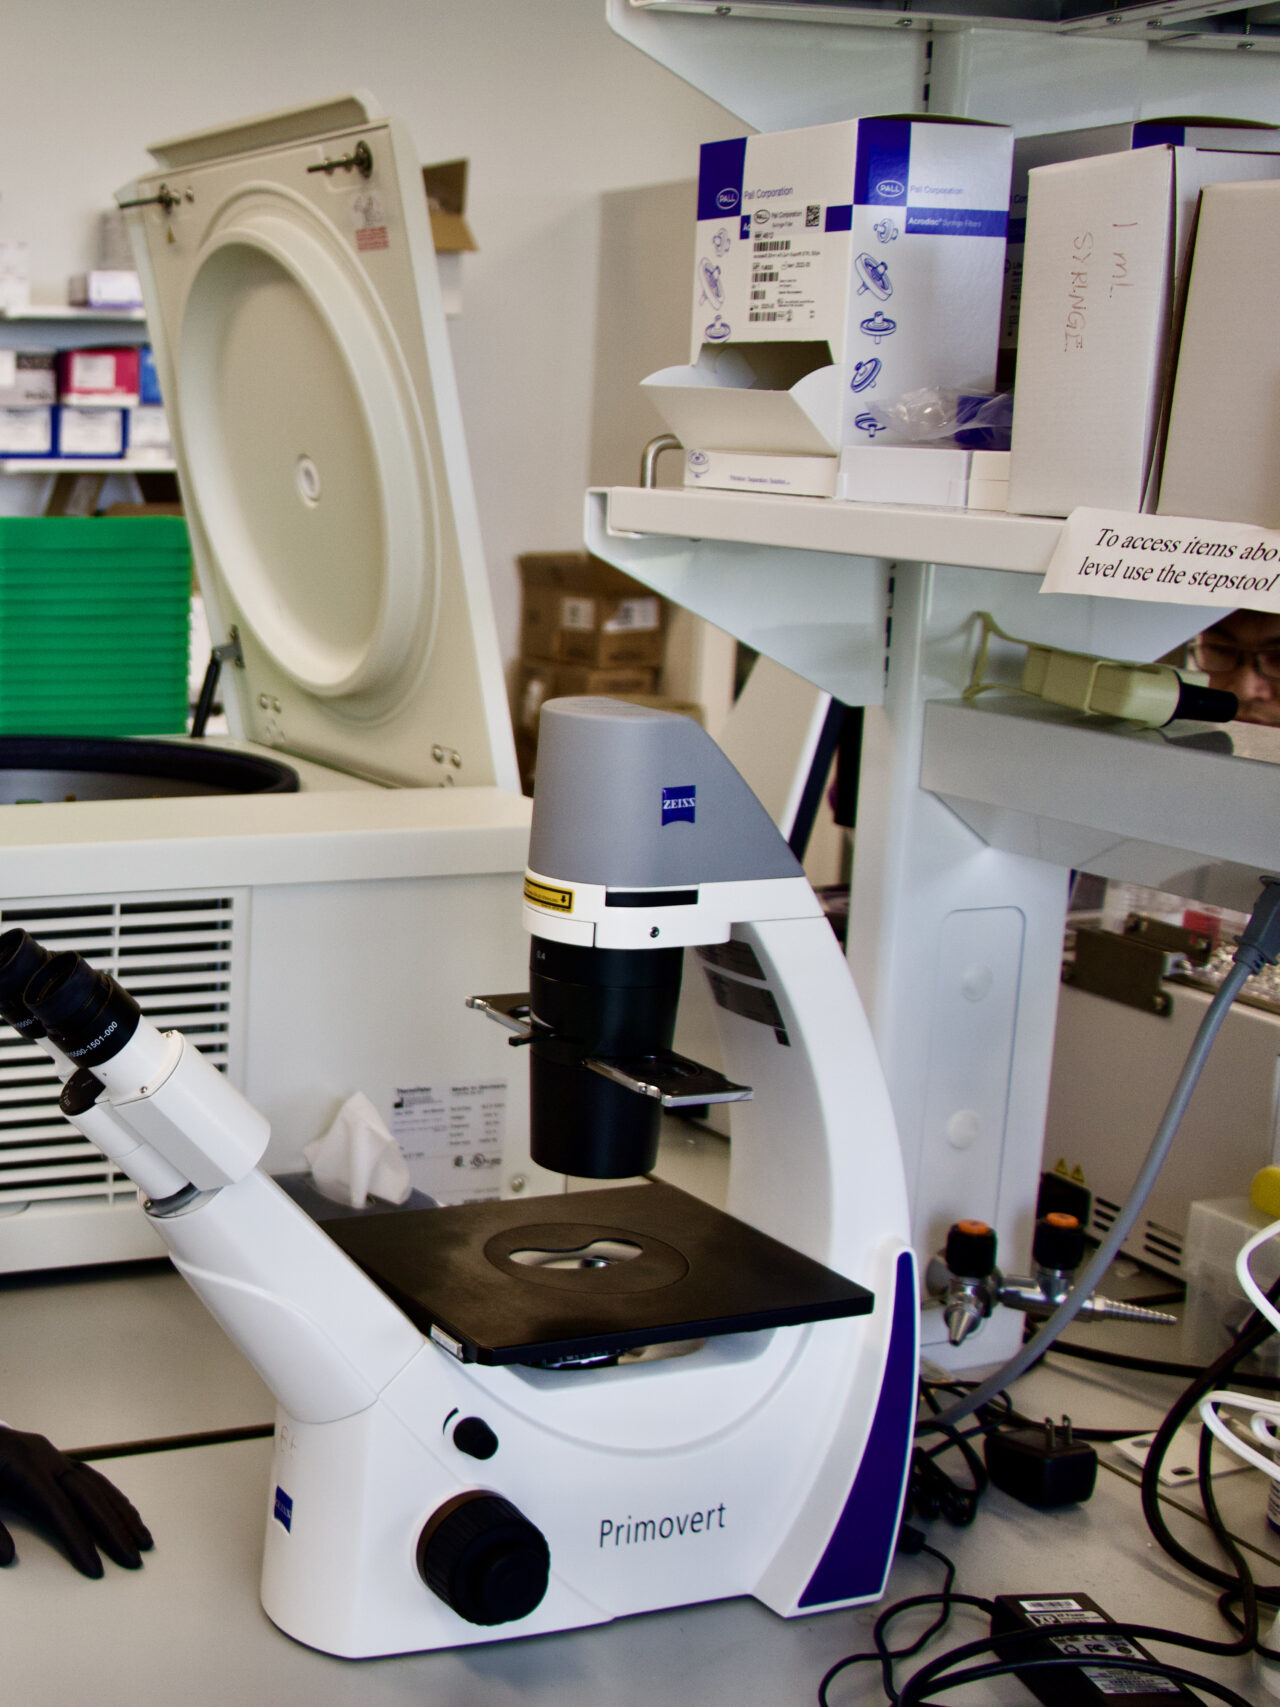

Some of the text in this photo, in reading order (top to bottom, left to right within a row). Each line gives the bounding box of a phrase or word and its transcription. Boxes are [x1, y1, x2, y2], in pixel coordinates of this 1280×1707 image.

[743, 187, 793, 200] Pall Corporation
[879, 184, 901, 193] PALL
[909, 185, 964, 195] Pall Corporation
[719, 193, 736, 203] PALL
[1094, 527, 1120, 548] To
[1120, 535, 1182, 554] access
[1181, 535, 1238, 559] items
[1077, 556, 1280, 593] level use the stepstool
[662, 797, 697, 810] ZEISS
[599, 1502, 727, 1549] Primovert
